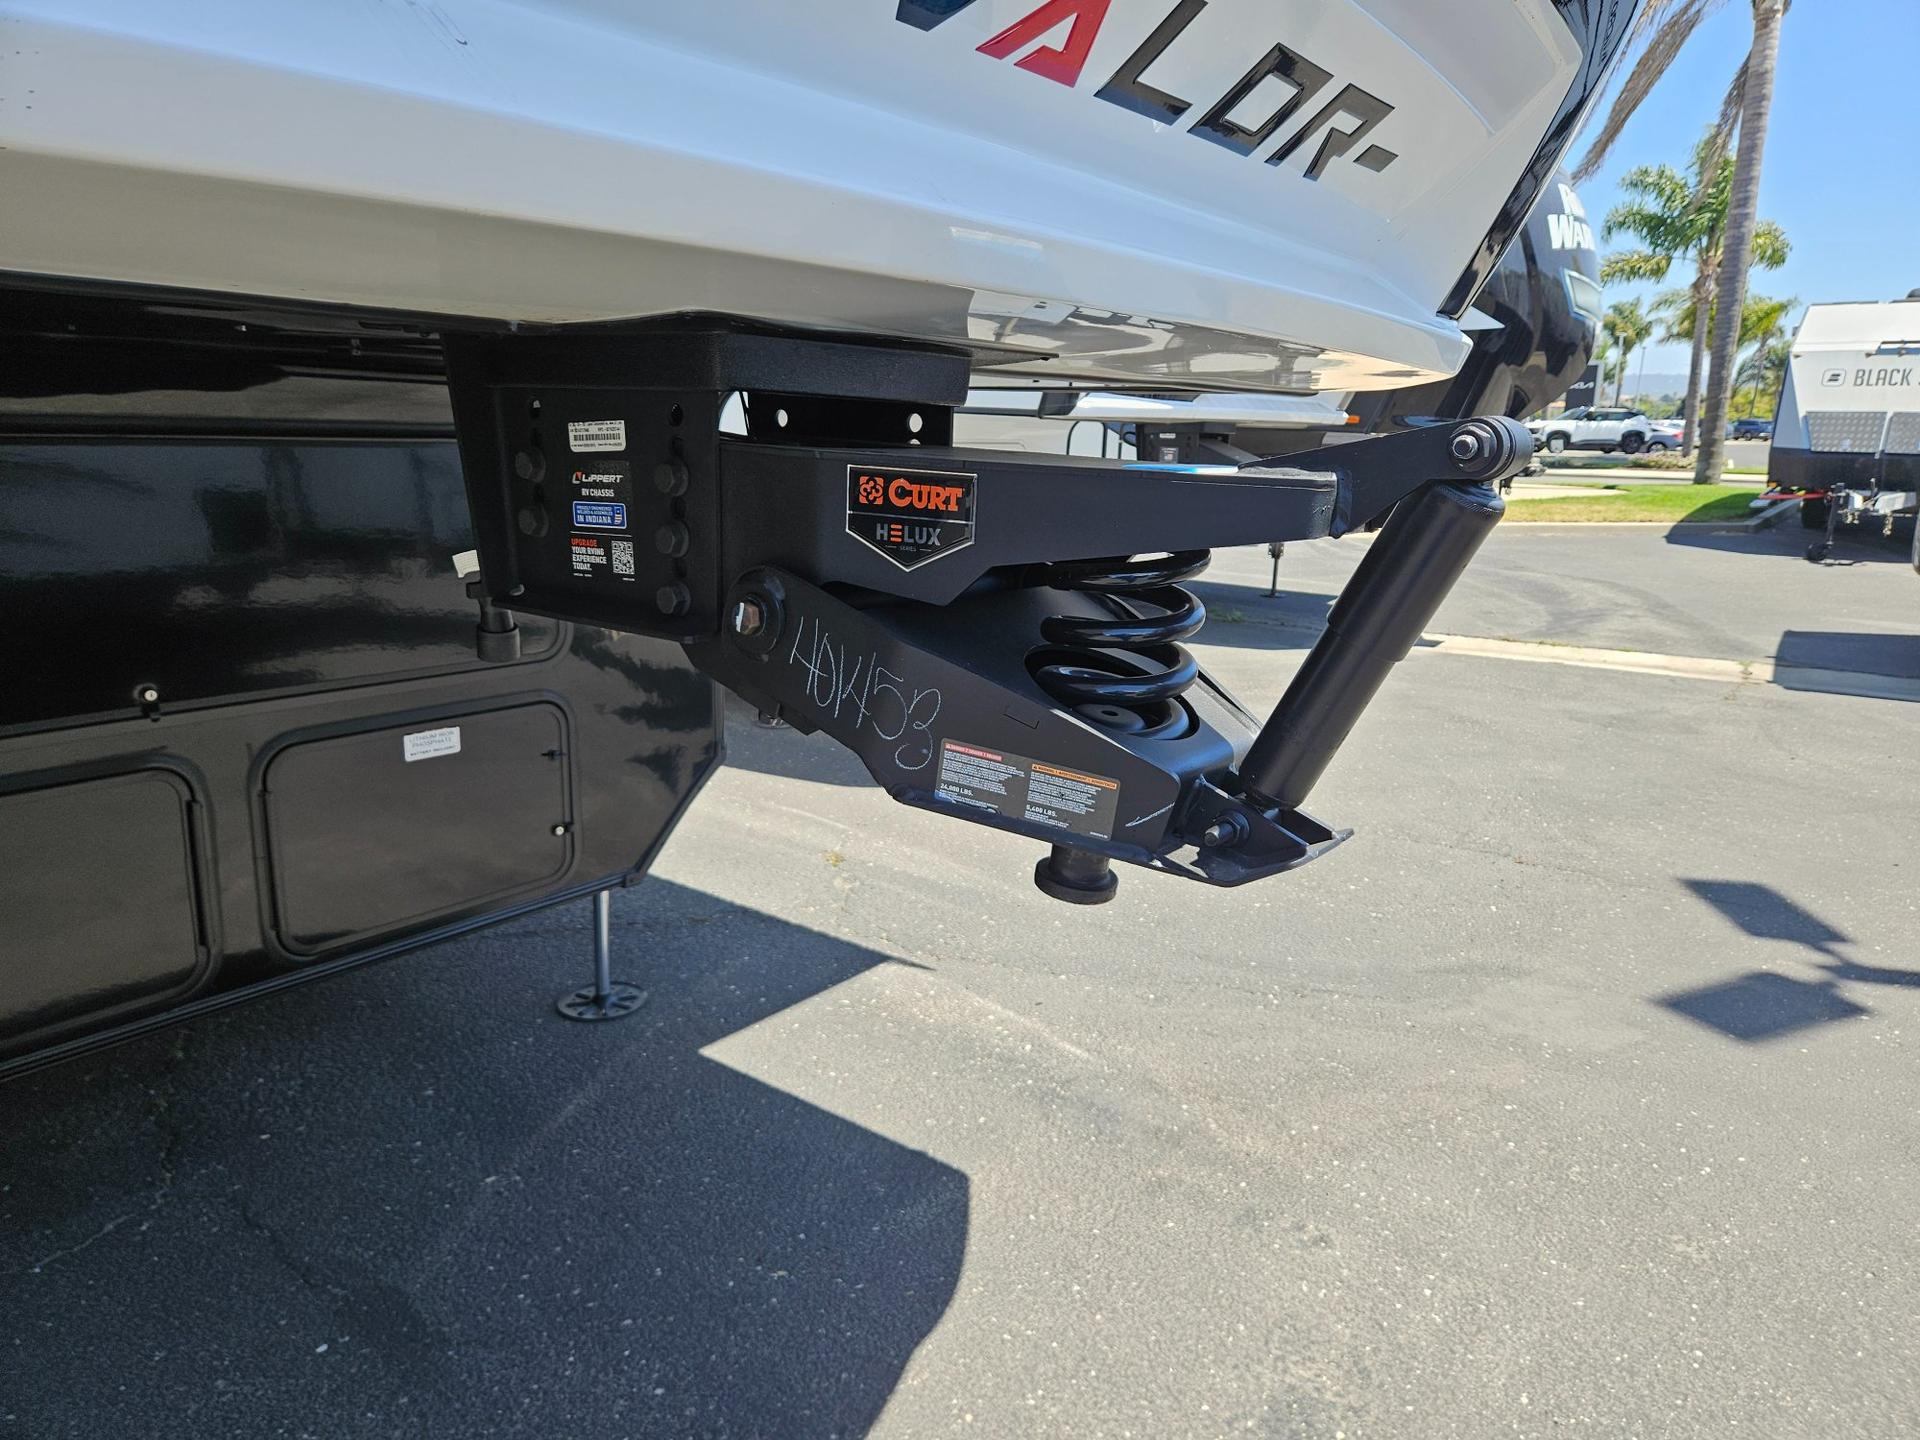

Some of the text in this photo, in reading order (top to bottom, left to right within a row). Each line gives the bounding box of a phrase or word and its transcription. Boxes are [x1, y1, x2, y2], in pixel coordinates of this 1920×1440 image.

[1853, 368, 1913, 387] BLACK
[582, 473, 624, 484] LIPPERT
[581, 487, 615, 497] RV CHASSIS
[888, 478, 965, 512] CURT
[576, 514, 613, 524] IN INDIANA
[875, 522, 942, 547] HELUX
[571, 538, 598, 547] UPGRADE
[571, 546, 587, 554] YOUR
[572, 554, 608, 564] EXPERIENCE
